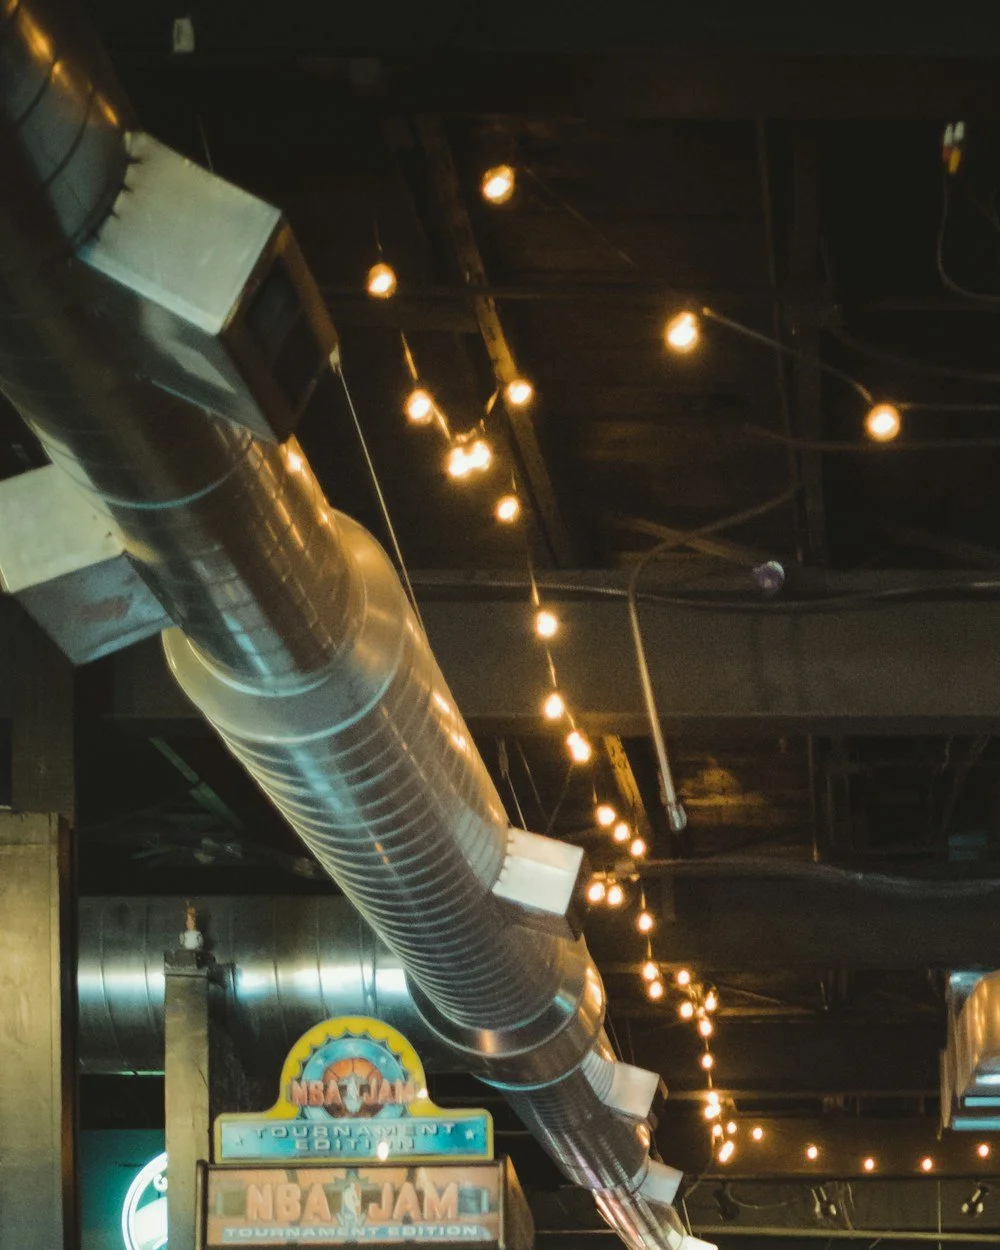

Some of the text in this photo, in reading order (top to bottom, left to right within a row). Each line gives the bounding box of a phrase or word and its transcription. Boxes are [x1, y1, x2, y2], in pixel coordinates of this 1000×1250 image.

[290, 1076, 415, 1106] NBA JAM
[254, 1122, 456, 1139] TOURNAMENT
[246, 1181, 459, 1222] NBA JAM
[223, 1224, 479, 1239] TOURNAMENT EDITION
